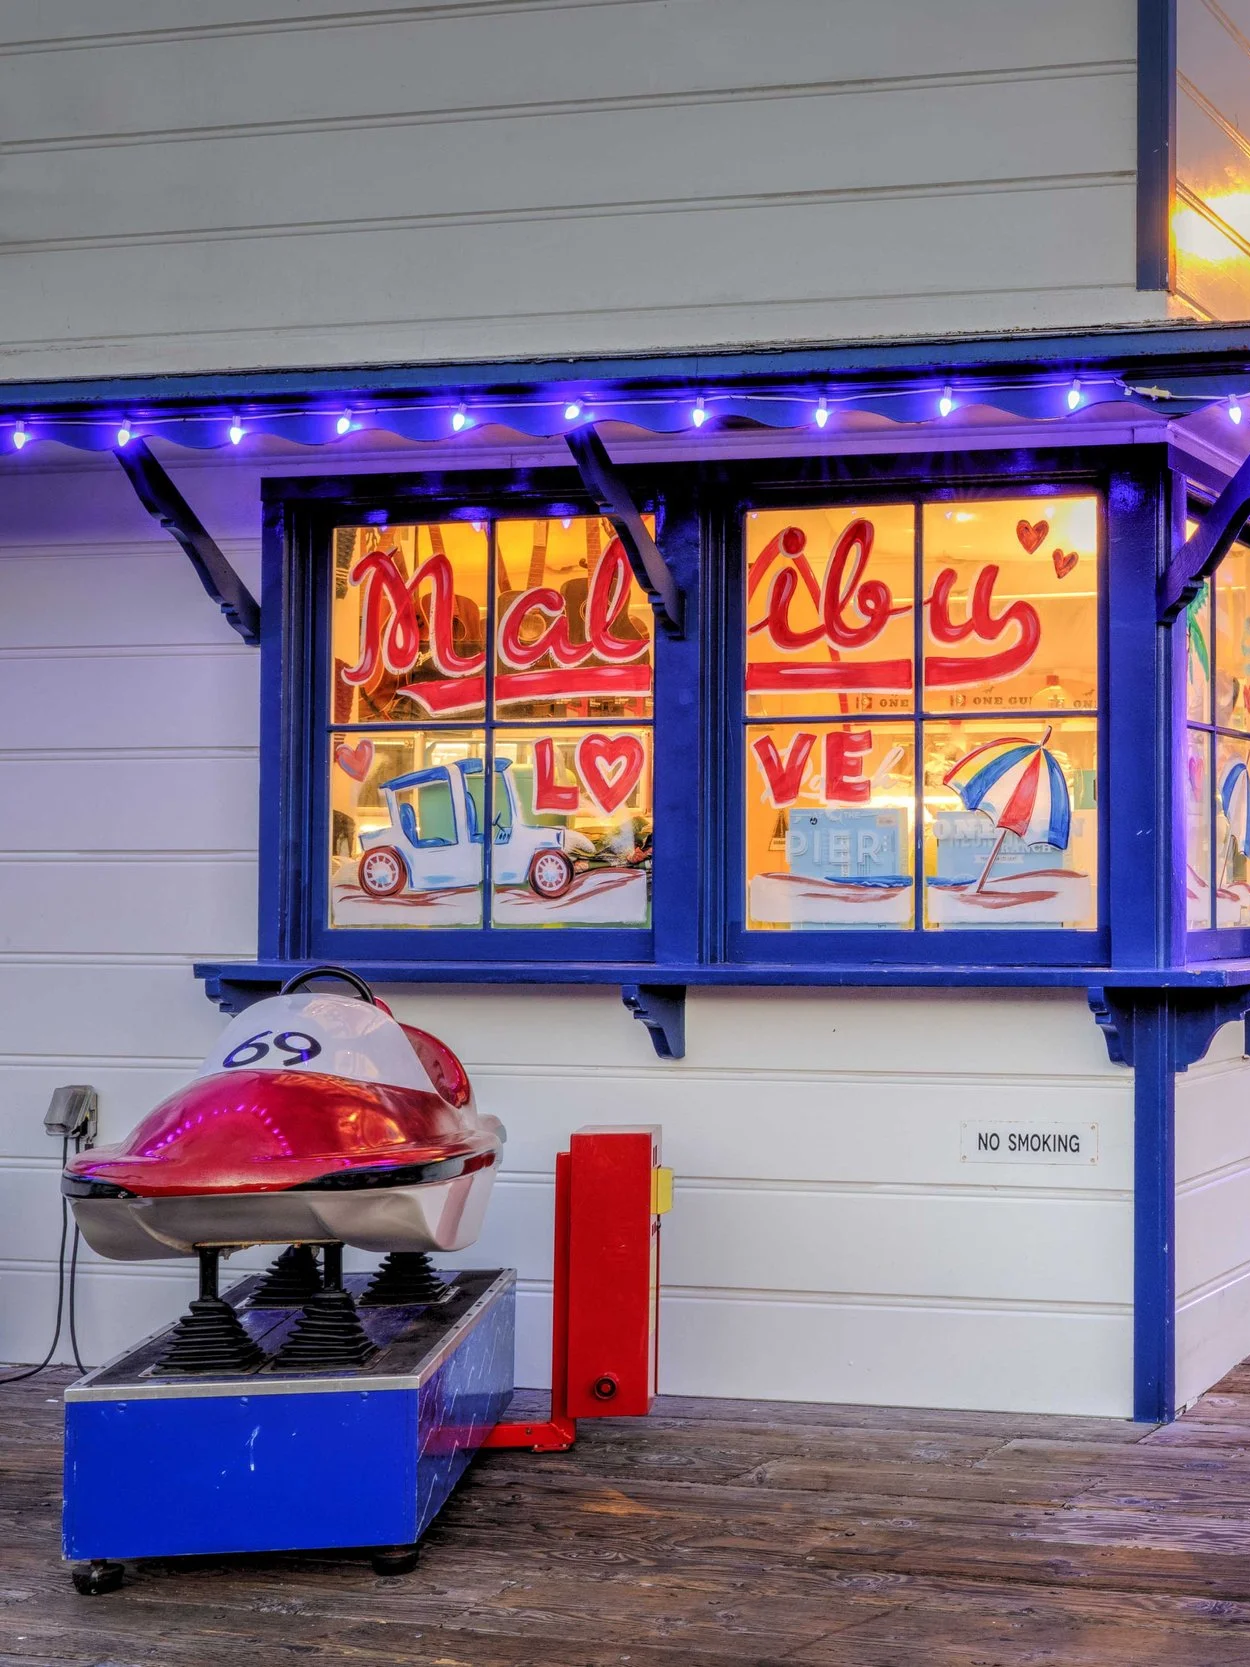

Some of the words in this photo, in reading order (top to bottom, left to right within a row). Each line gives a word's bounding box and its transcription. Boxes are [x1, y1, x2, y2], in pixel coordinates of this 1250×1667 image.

[879, 698, 909, 708] ONE
[972, 696, 1003, 706] ONE
[1073, 699, 1097, 709] ON
[785, 829, 881, 865] PIER
[223, 1030, 322, 1069] 69
[978, 1132, 1000, 1151] NO
[1008, 1133, 1080, 1153] SMOKING
